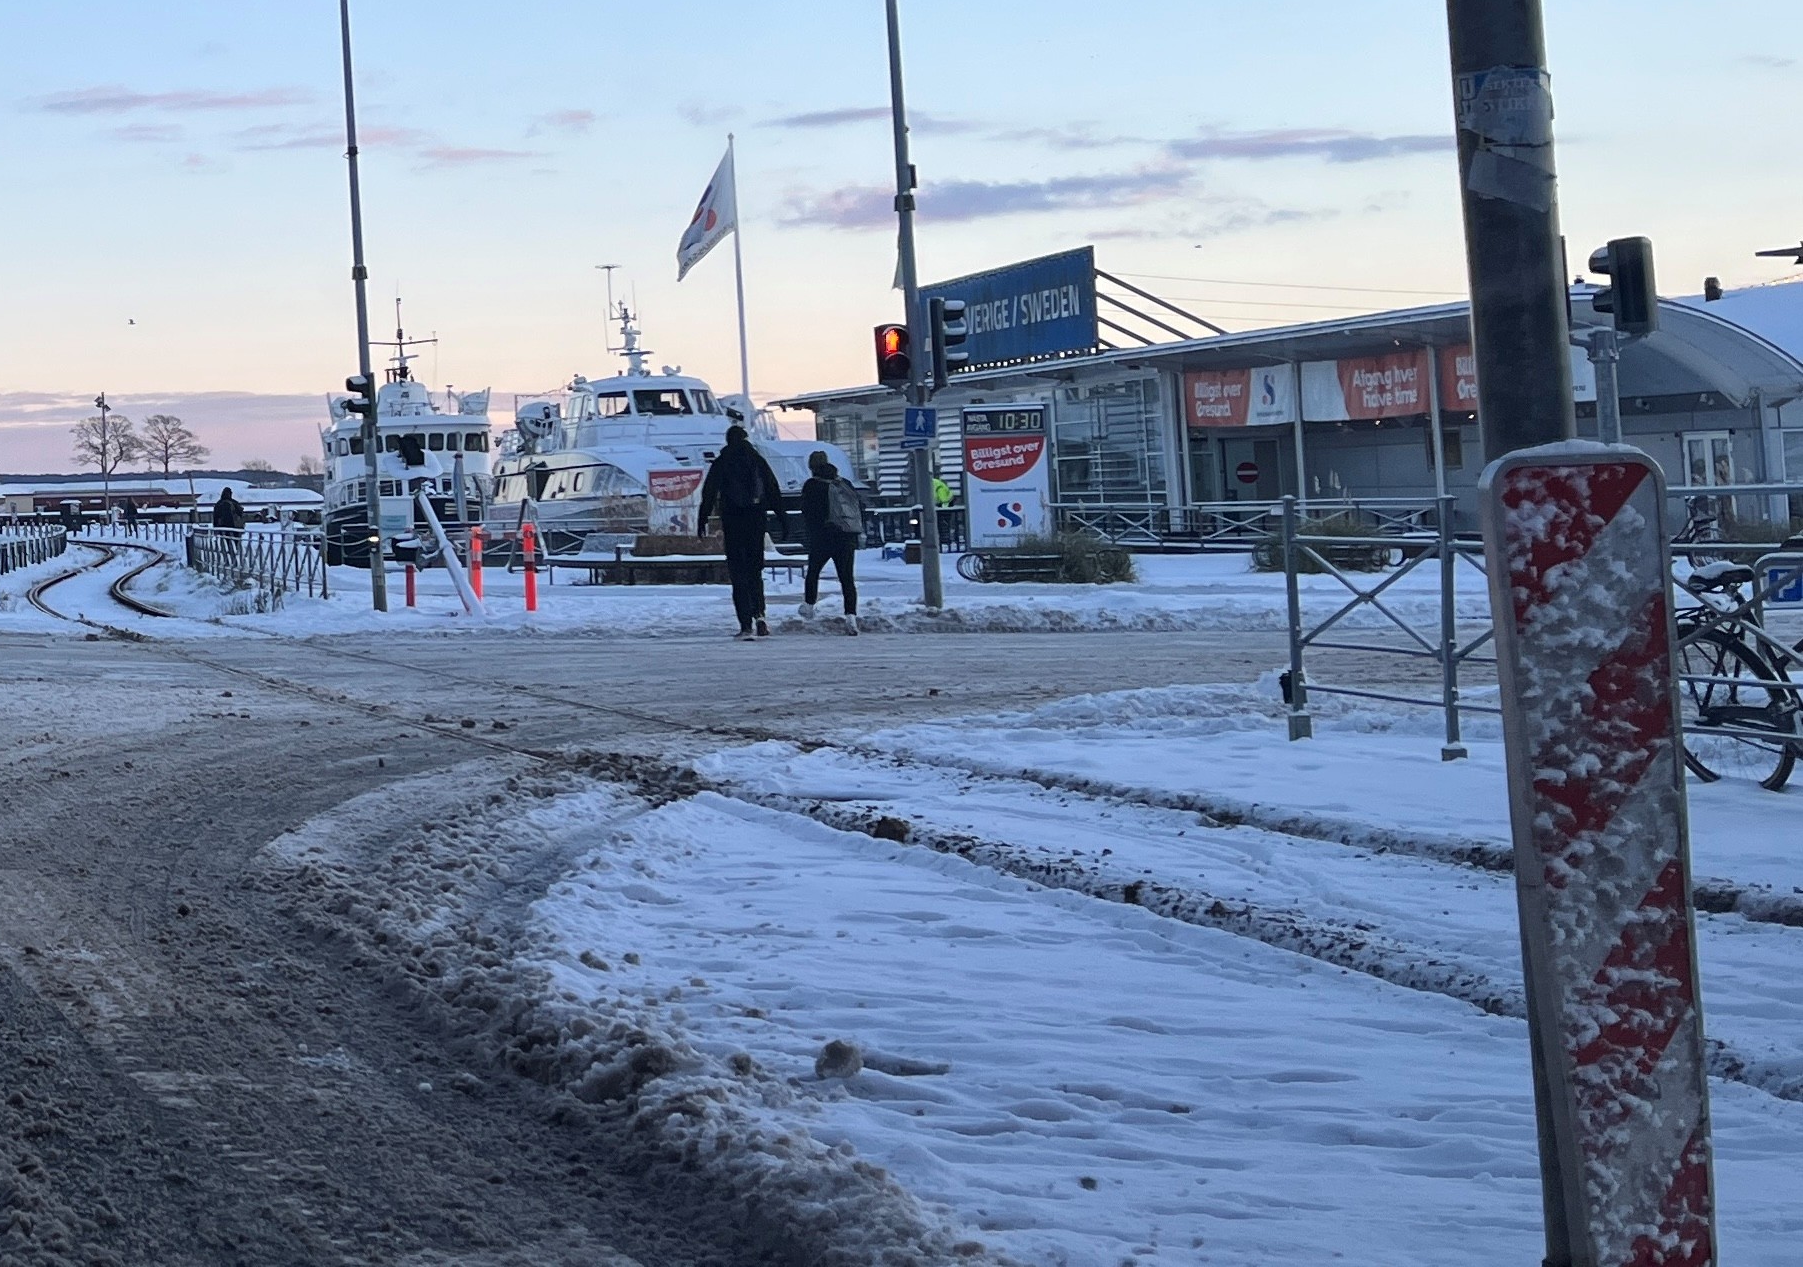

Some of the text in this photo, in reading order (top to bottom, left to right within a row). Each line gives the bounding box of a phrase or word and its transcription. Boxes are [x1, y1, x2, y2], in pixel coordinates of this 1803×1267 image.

[961, 298, 1010, 335] VERIGE
[1020, 284, 1080, 325] SWEDEN
[998, 413, 1041, 430] 10:30
[970, 442, 1040, 460] Billigst over
[972, 454, 1025, 472] Øresund
